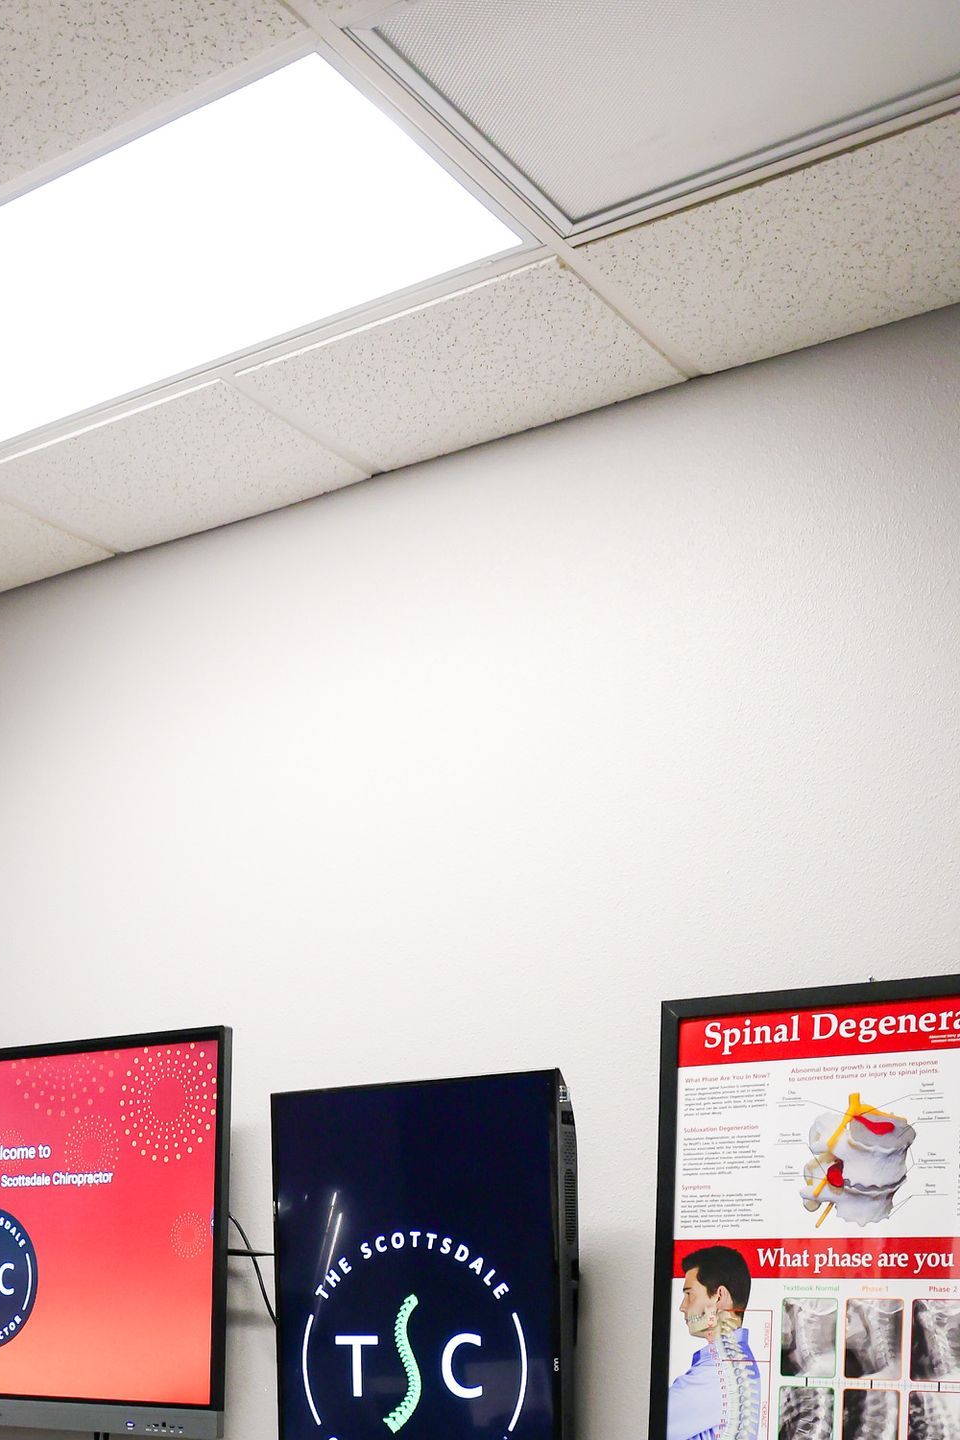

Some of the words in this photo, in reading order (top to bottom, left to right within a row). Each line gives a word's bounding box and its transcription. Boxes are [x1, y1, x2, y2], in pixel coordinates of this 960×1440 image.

[704, 1014, 800, 1055] Spinal
[791, 1066, 822, 1075] Abnormal
[823, 1065, 839, 1074] bony
[841, 1063, 865, 1072] growth
[908, 1060, 939, 1068] response
[868, 1071, 887, 1079] injury
[898, 1068, 918, 1077] spinal
[919, 1067, 940, 1076] joints.
[719, 1124, 759, 1132] Degeneration
[37, 1143, 51, 1159] to
[0, 1171, 51, 1187] Scottsdale
[52, 1170, 114, 1187] Chiropractor
[315, 1257, 353, 1301] THE
[360, 1230, 510, 1301] SCOTTSDALE
[757, 1247, 809, 1268] What
[813, 1249, 872, 1273] phase
[878, 1253, 908, 1268] are
[913, 1252, 955, 1274] you
[929, 1285, 951, 1293] Phase
